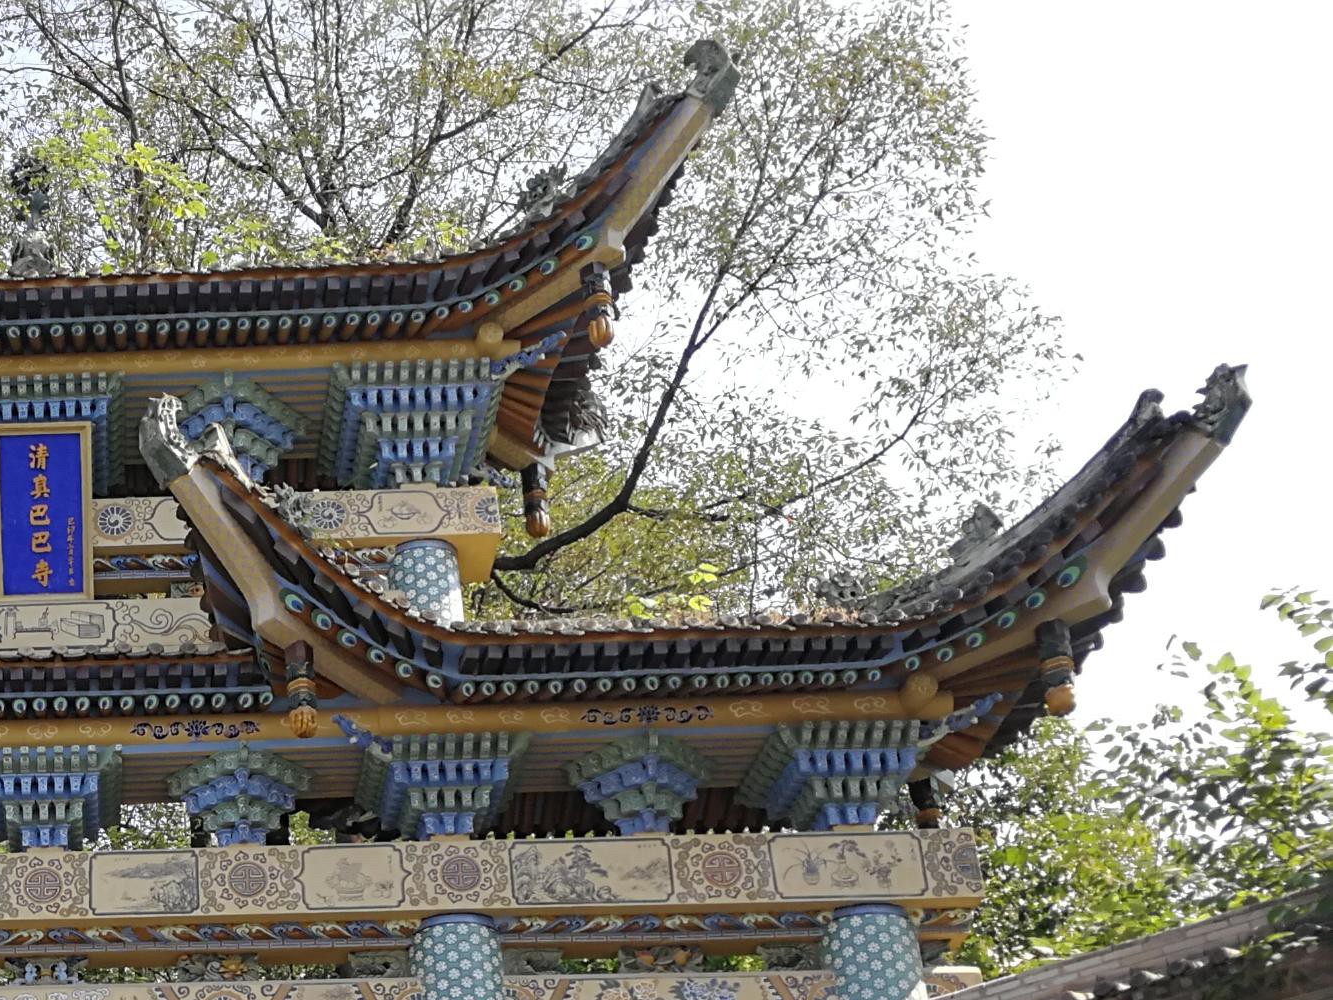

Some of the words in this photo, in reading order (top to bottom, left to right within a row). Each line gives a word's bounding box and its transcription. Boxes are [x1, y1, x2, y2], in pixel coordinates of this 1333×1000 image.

[28, 443, 53, 588] 清真巴巴寺
